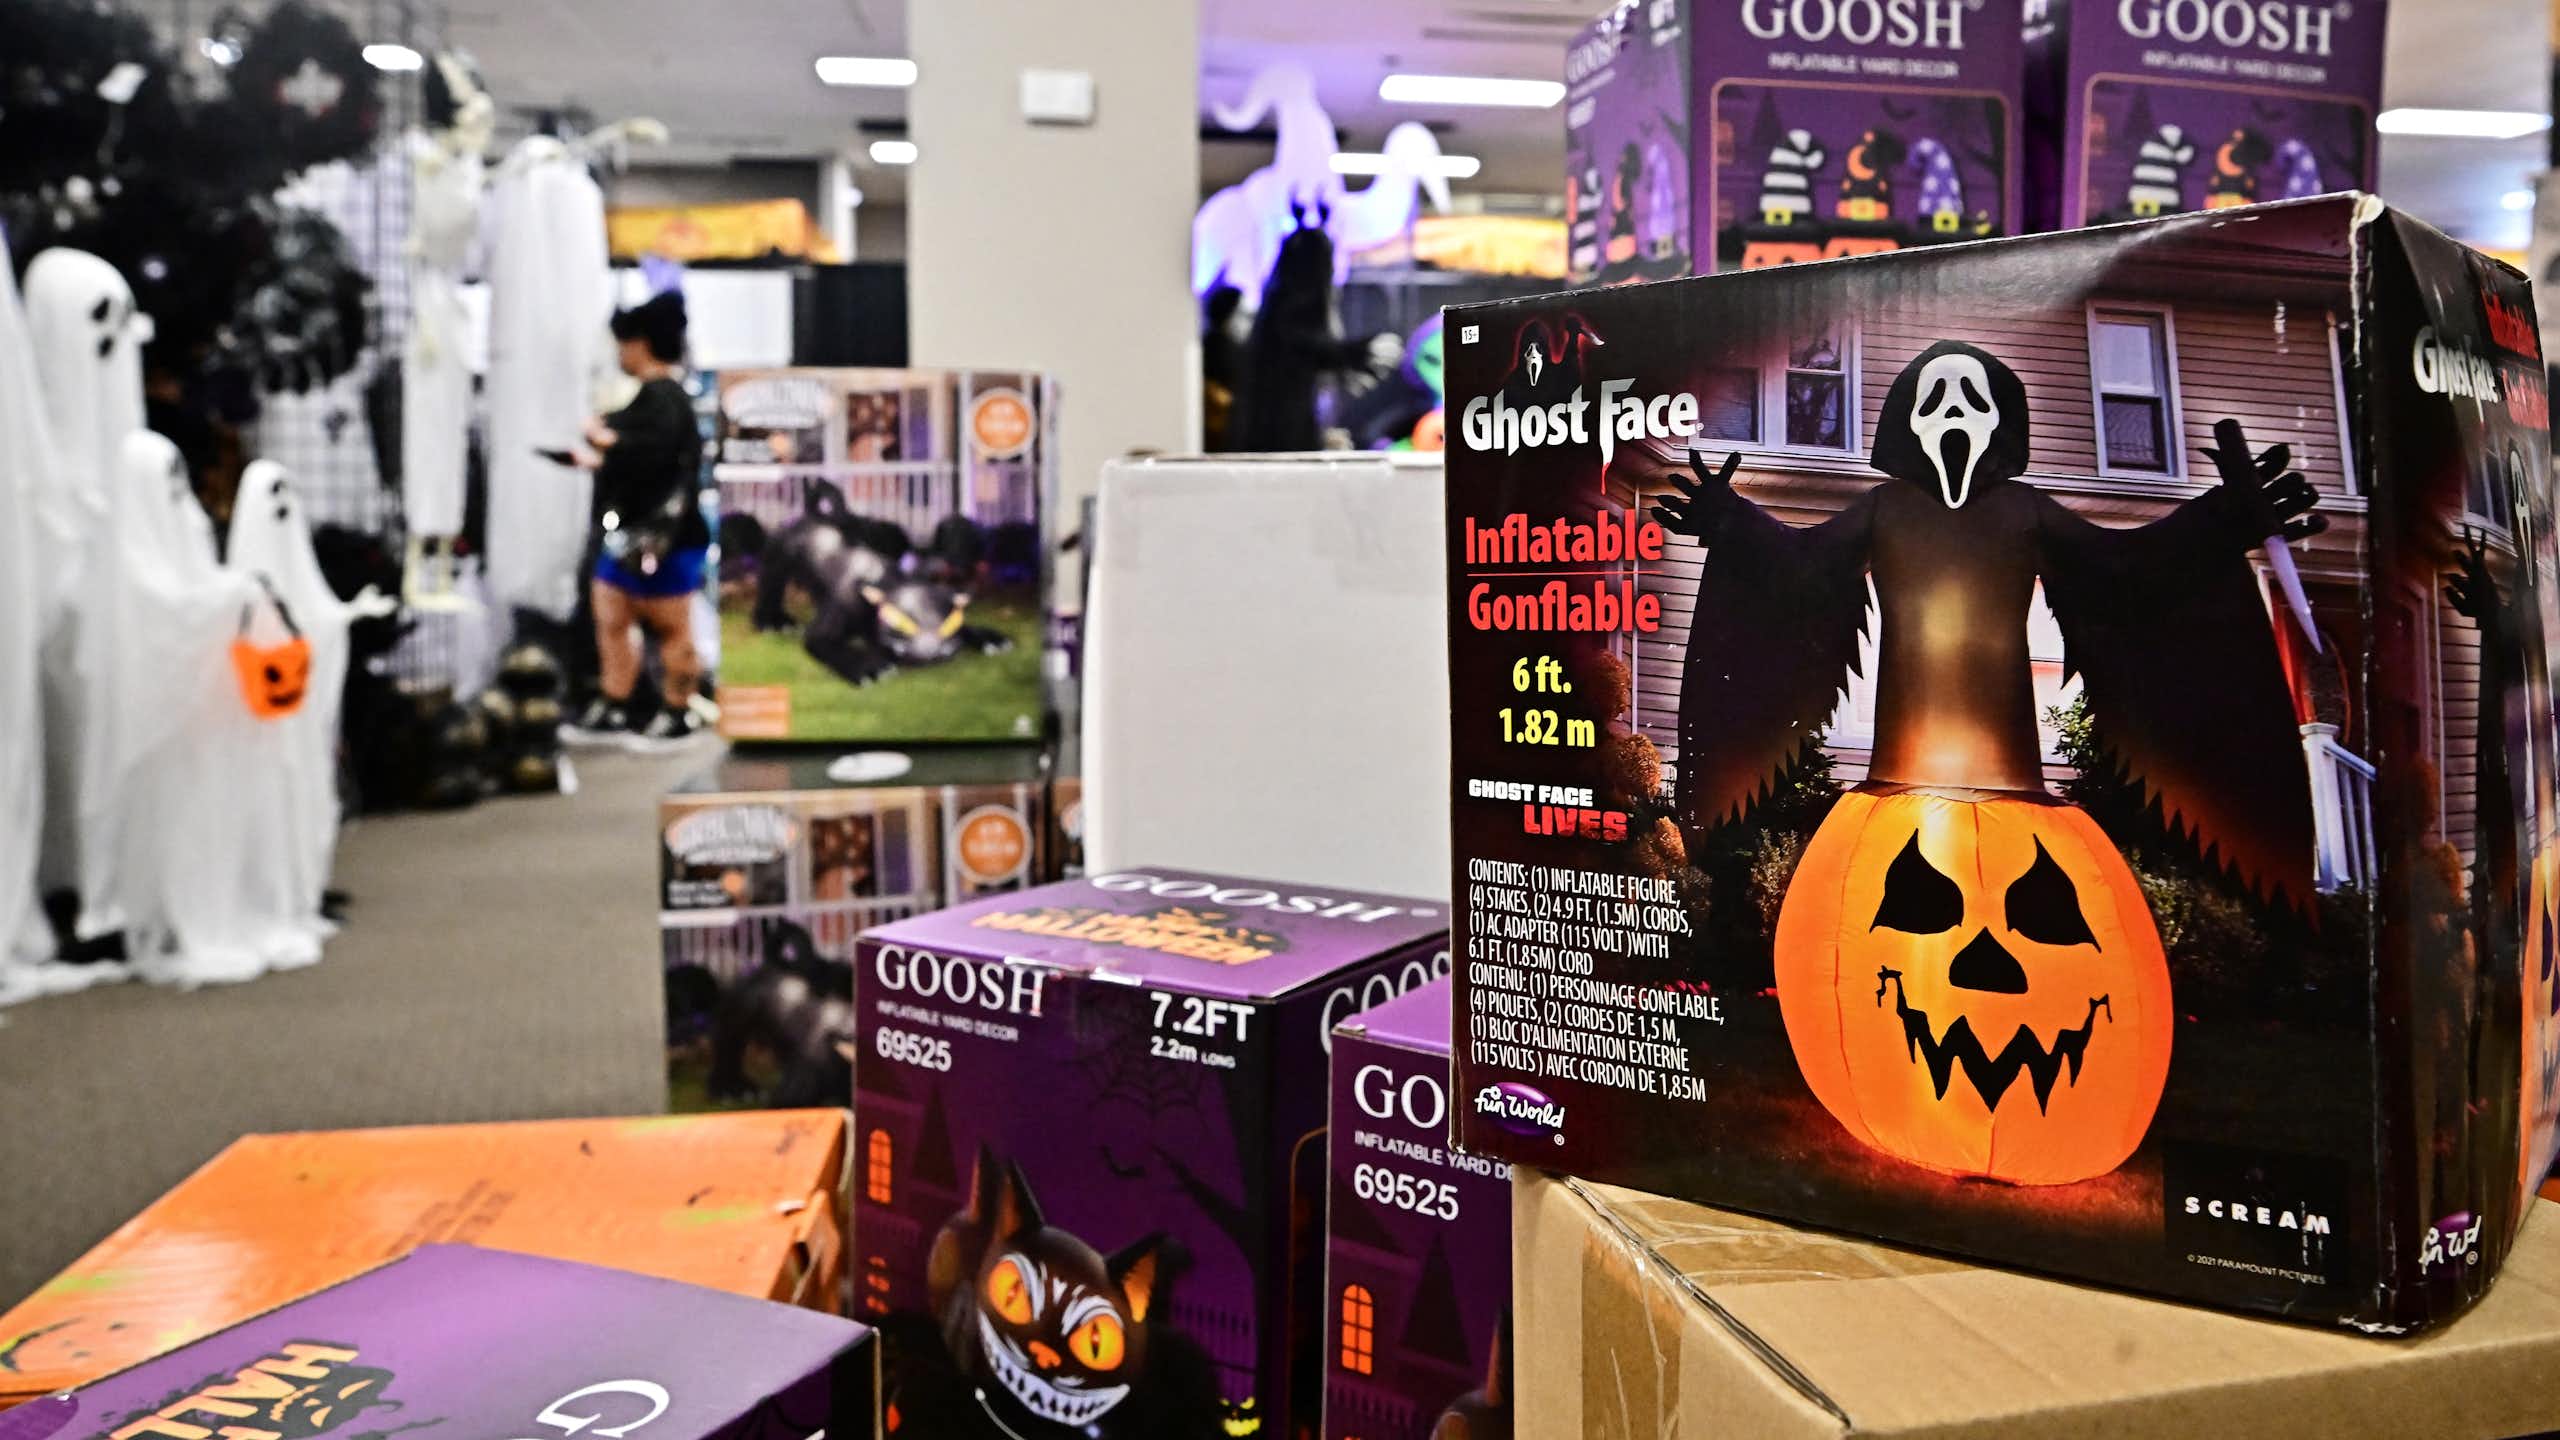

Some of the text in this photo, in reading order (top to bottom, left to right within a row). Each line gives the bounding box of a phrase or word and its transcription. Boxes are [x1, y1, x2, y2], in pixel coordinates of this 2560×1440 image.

[1742, 0, 1964, 49] GOOSH
[2118, 0, 2332, 56] GOOSH
[1462, 378, 1700, 467] Ghost Face
[1466, 509, 1664, 564] Inflatable
[1468, 580, 1660, 632] Gonflable
[1512, 655, 1572, 693] 6 ft.
[1498, 708, 1595, 748] 1.82 m
[1468, 779, 1593, 808] GHOST FACE
[1523, 804, 1628, 842] LIVES
[1092, 873, 1400, 923] GOOSH
[1469, 858, 1680, 908] CONTENTS: (1) INFLATABLE FIGURE,
[1469, 883, 1693, 938] (4) STAKES, (2) 4.9 FT. (1.5M) CORDS,
[1469, 910, 1484, 936] (1)
[1487, 912, 1502, 936] AC
[1504, 915, 1559, 944] ADAPTER
[1561, 922, 1589, 949] (115
[1591, 927, 1623, 953] VOLT
[1469, 936, 1593, 975] 6.1 FT. (1.85M) CORD
[876, 944, 1046, 1017] GOOSH
[1469, 962, 1724, 1025] CONTENU: (1) PERSONNAGE GONFLABLE,
[1150, 991, 1256, 1042] 7.2FT
[1470, 987, 1485, 1014] (4)
[1488, 991, 1541, 1024] PIQUETS,
[1544, 1000, 1561, 1028] (2)
[1565, 1004, 1615, 1032] CORDES
[1617, 1011, 1636, 1036] DE
[1638, 1016, 1659, 1041] 1,5
[876, 1026, 952, 1072] 69525
[1150, 1035, 1197, 1063] 2.2m
[1470, 1013, 1690, 1072] (1) BLOC D'ALIMENTATION EXTERNE
[1546, 1053, 1578, 1080] AVEC
[1580, 1059, 1635, 1090] CORDON
[1638, 1068, 1657, 1094] DE
[1659, 1073, 1707, 1102] 1,85M
[1475, 1086, 1565, 1129] fun World
[1354, 1130, 1444, 1166] INFLATABLE
[1447, 1152, 1491, 1176] YARD
[1354, 1163, 1459, 1221] 69525
[2185, 1196, 2331, 1235] SCREAM
[2217, 1258, 2277, 1276] PARAMOUNT
[2279, 1269, 2326, 1285] PICTURES
